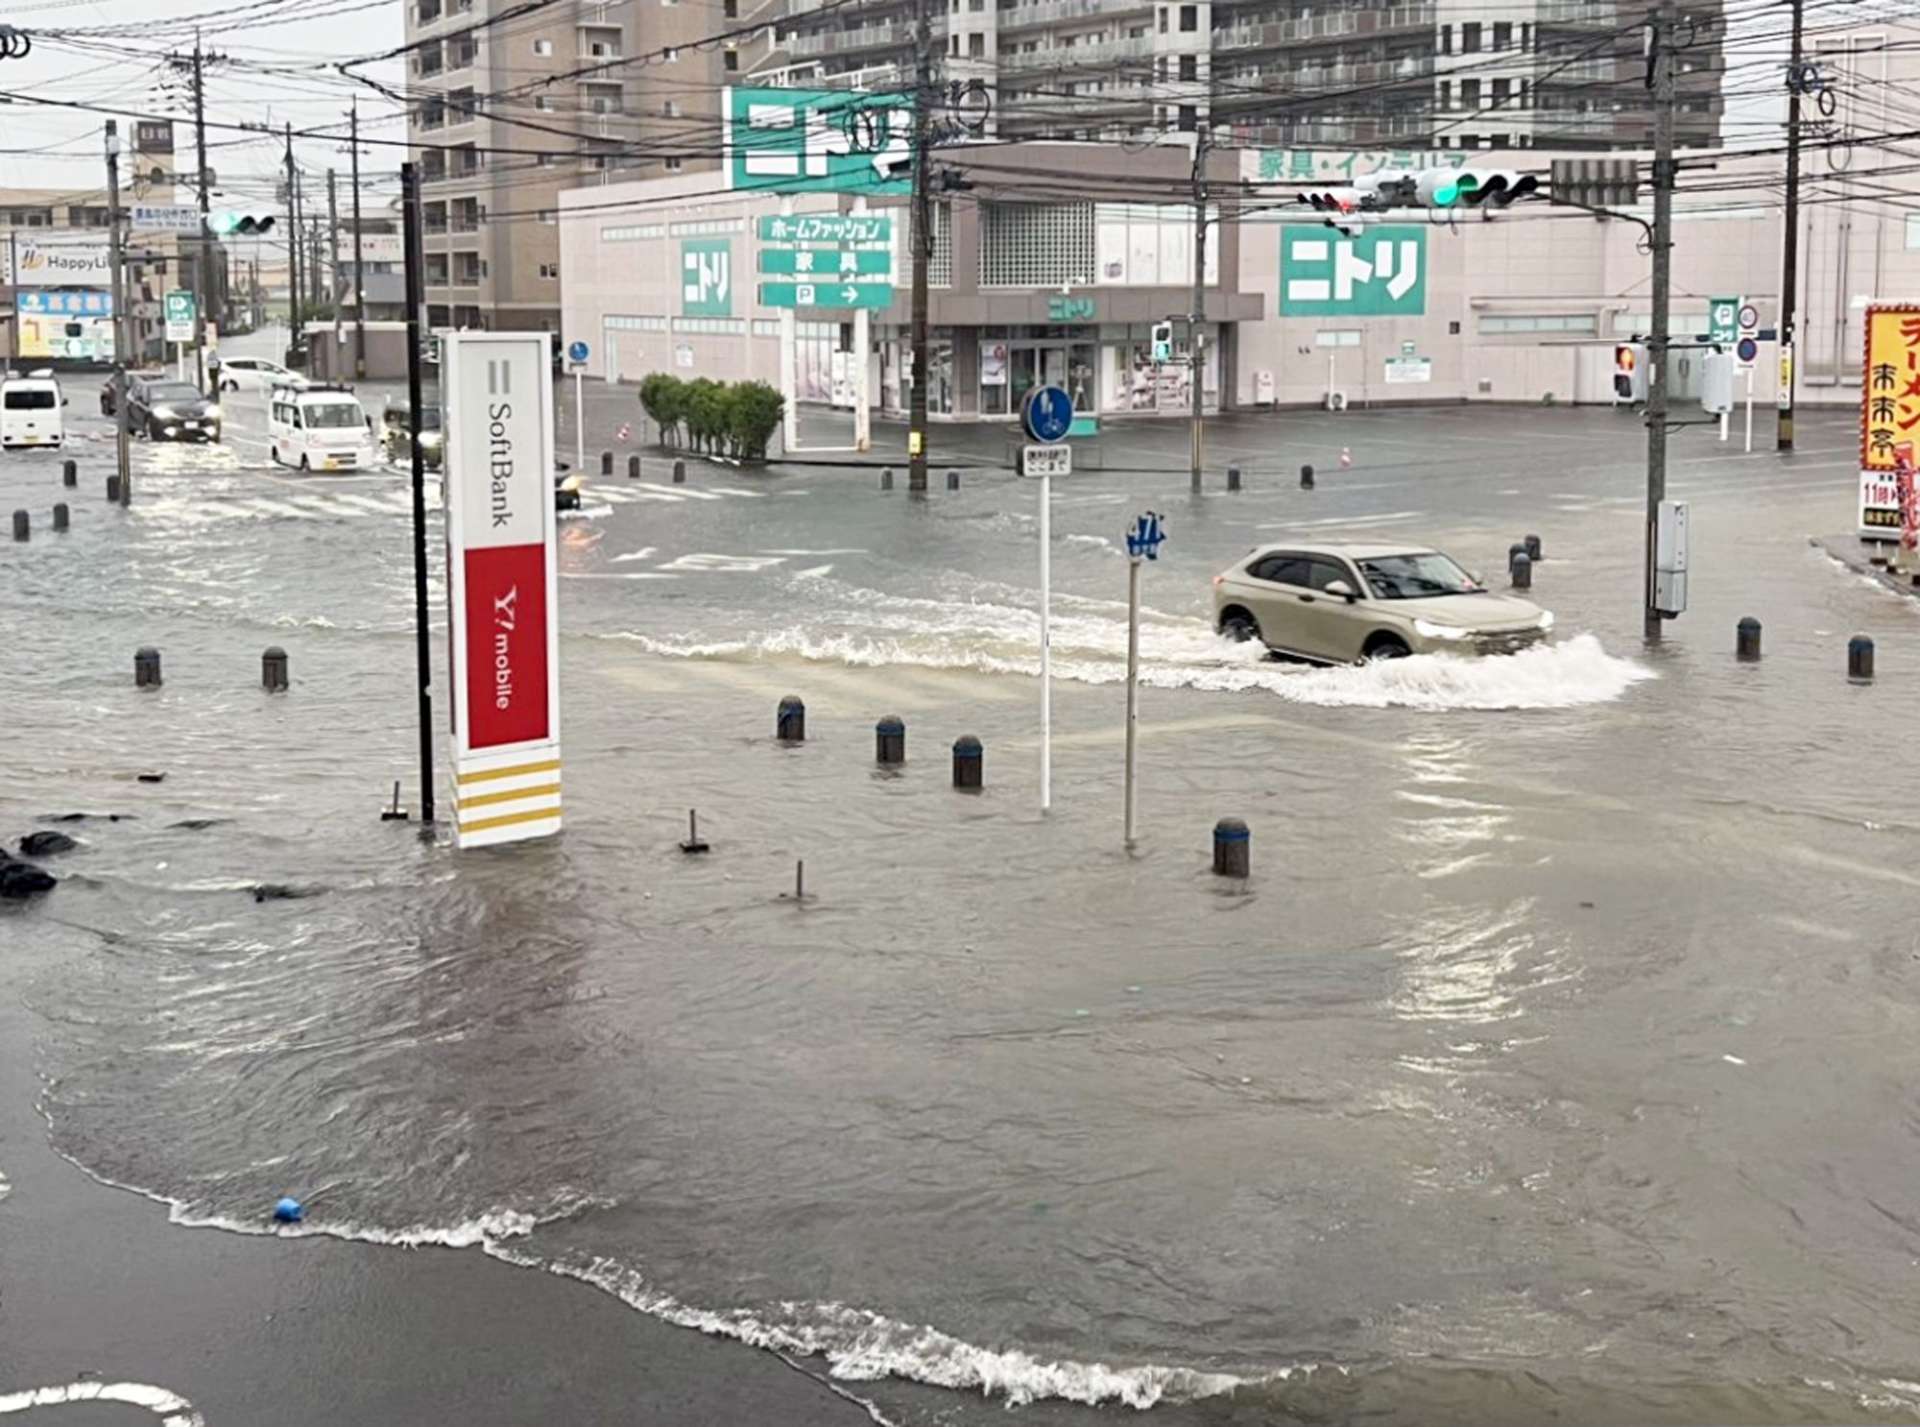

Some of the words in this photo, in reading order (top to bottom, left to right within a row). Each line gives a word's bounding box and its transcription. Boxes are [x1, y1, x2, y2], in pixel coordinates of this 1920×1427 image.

[771, 220, 880, 239] ホームファッション
[48, 256, 111, 271] HappyLi
[684, 252, 729, 303] ニトリ
[1288, 240, 1418, 301] ニトリ
[1048, 298, 1094, 321] ニトリ
[489, 402, 513, 528] SoftBank
